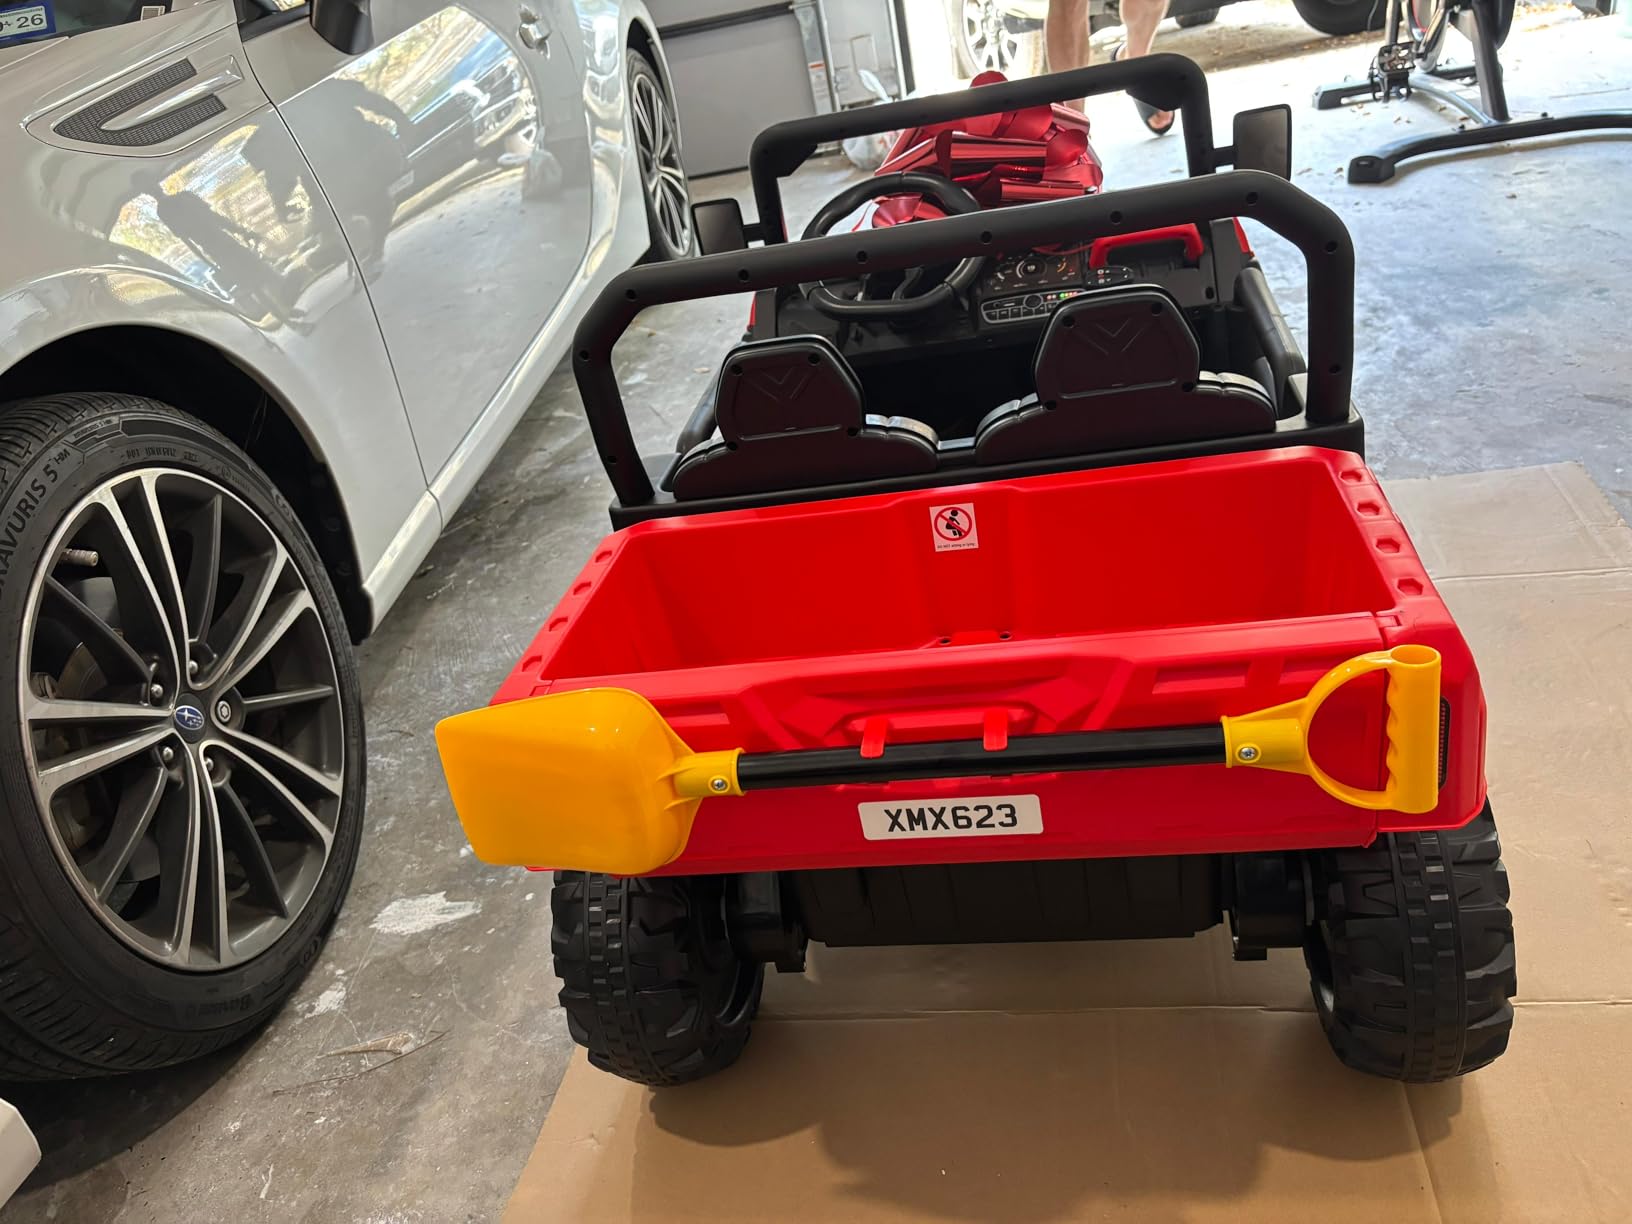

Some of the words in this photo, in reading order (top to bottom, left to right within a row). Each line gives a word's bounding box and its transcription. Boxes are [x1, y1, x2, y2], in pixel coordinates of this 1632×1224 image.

[16, 14, 43, 28] 26
[43, 463, 58, 483] 5
[884, 804, 1017, 832] XMX623
